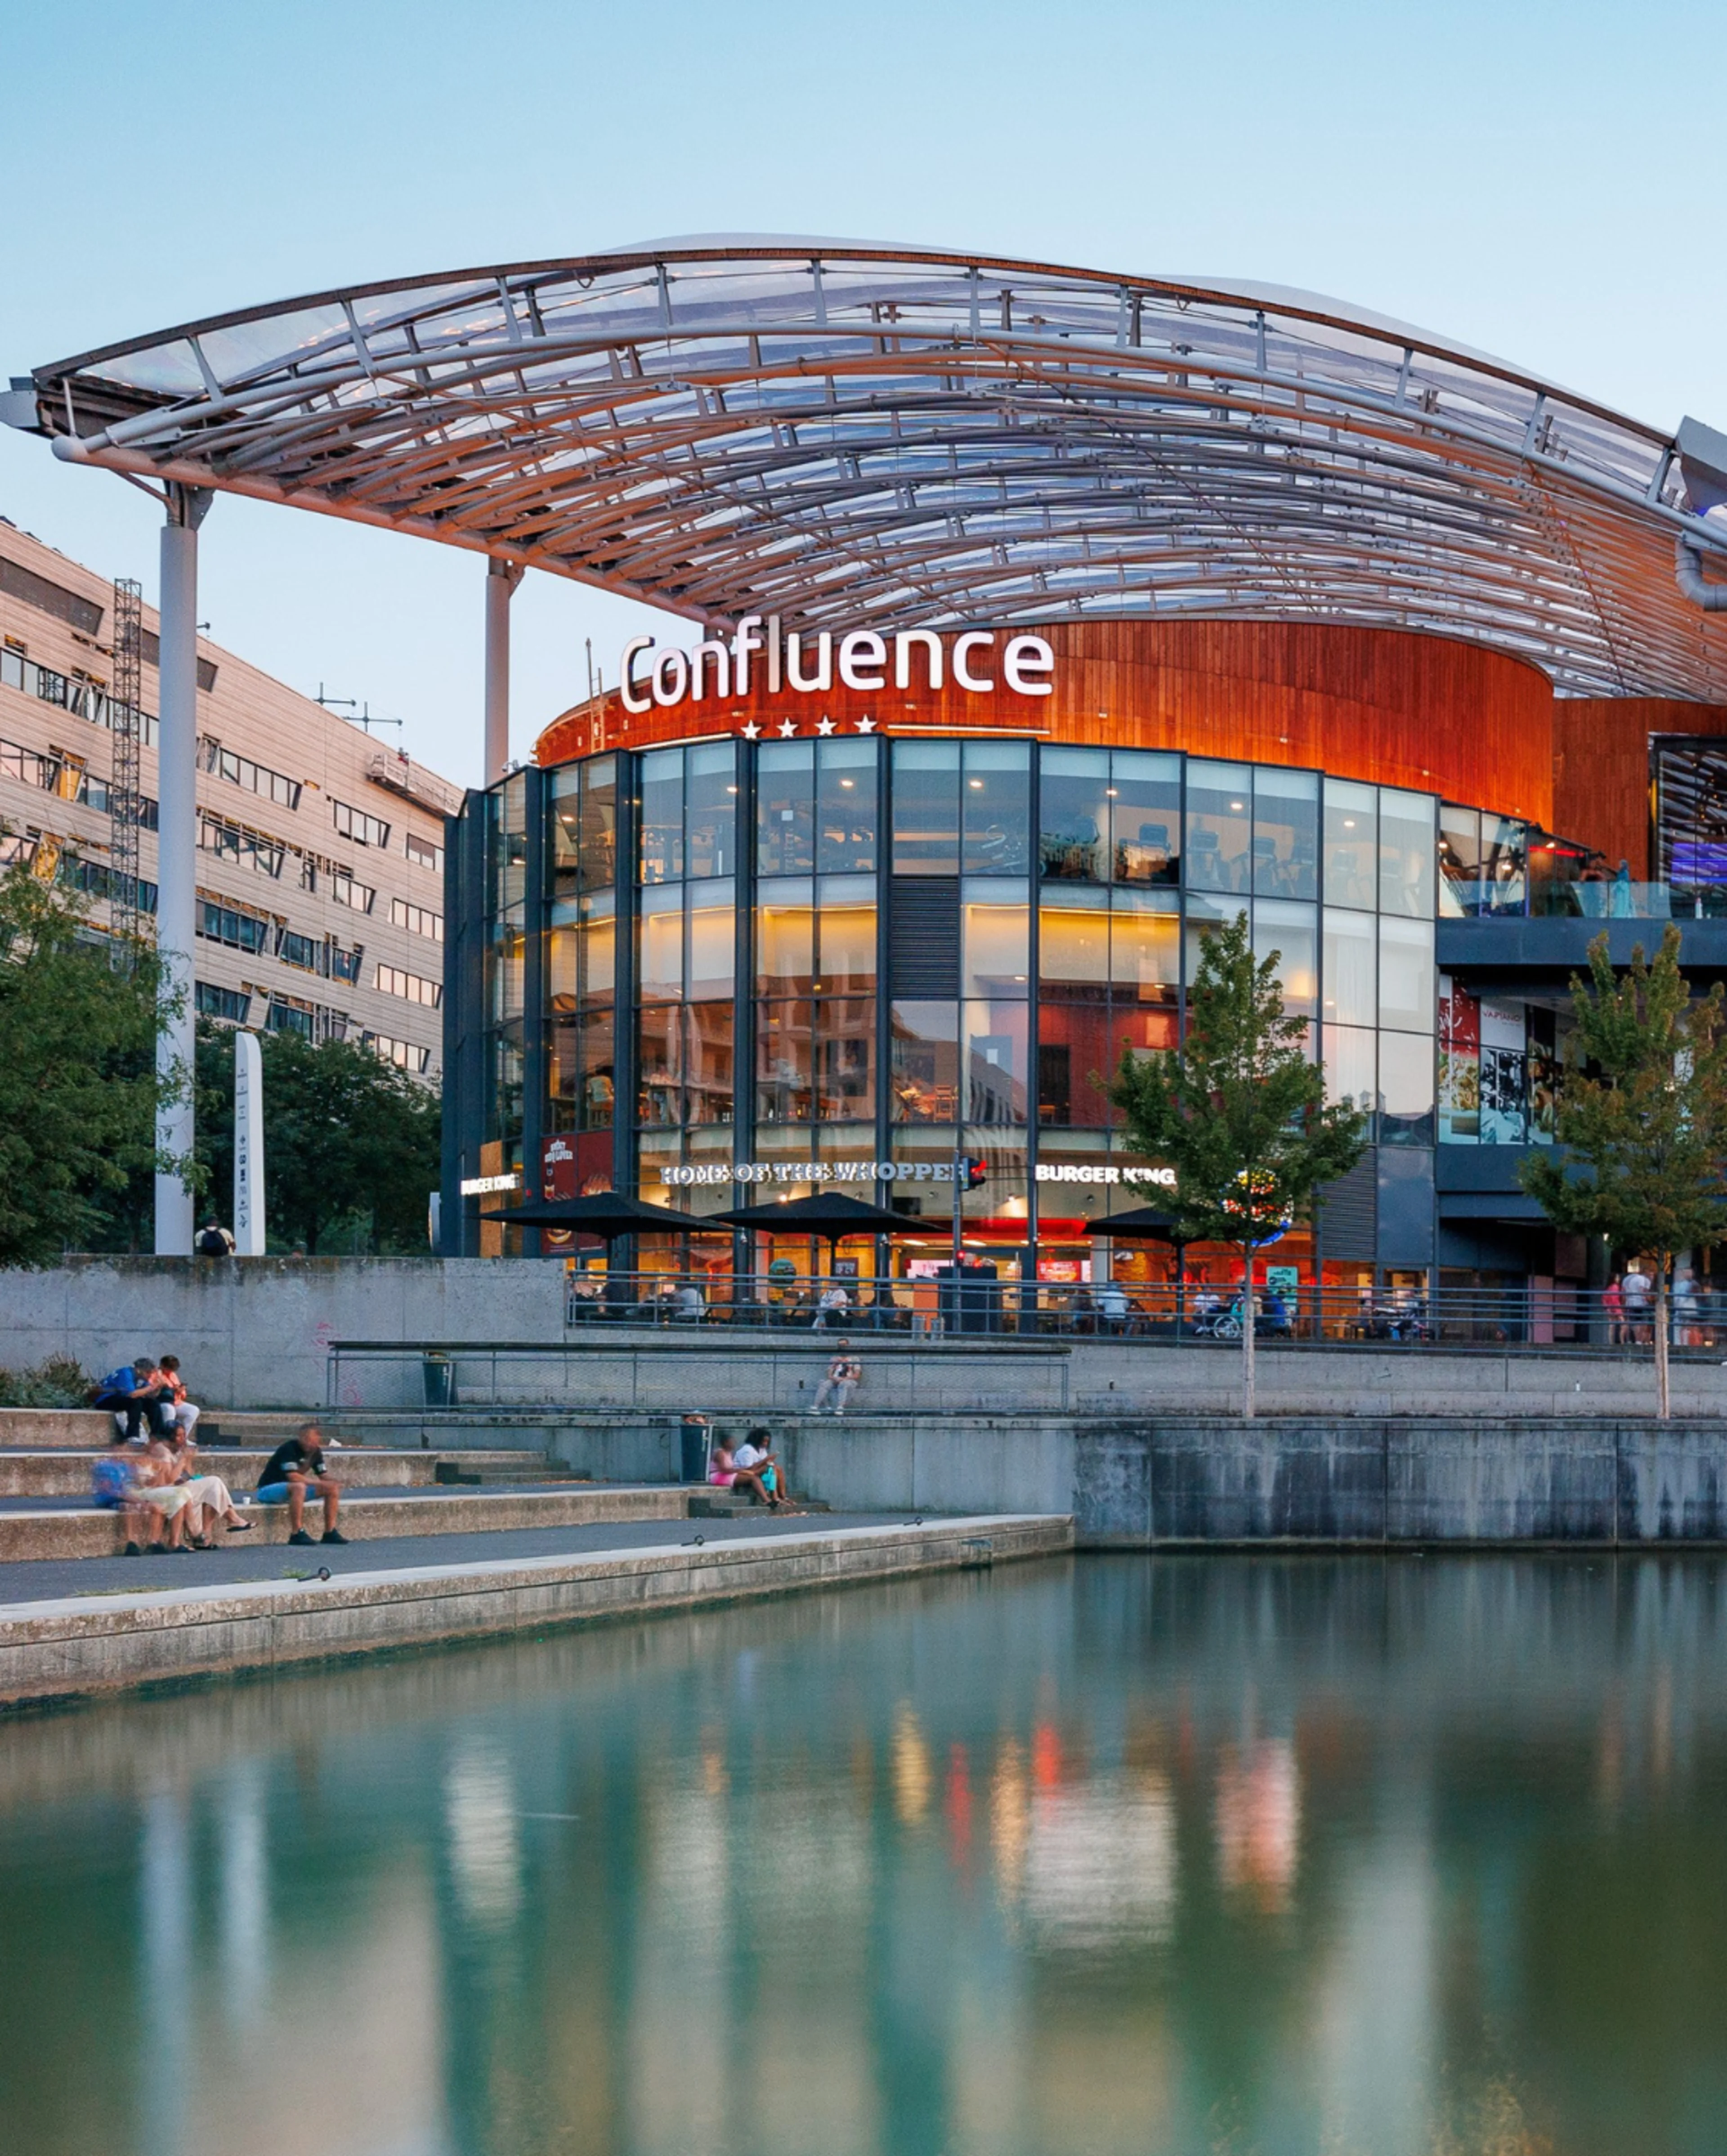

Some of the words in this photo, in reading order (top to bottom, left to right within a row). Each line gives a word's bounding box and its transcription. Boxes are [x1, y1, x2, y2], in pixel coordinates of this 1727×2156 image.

[620, 615, 1055, 714] Confluence
[660, 1164, 729, 1184] HOME
[734, 1163, 770, 1183] OF
[773, 1162, 828, 1182] THE
[1035, 1164, 1119, 1183] BURGER
